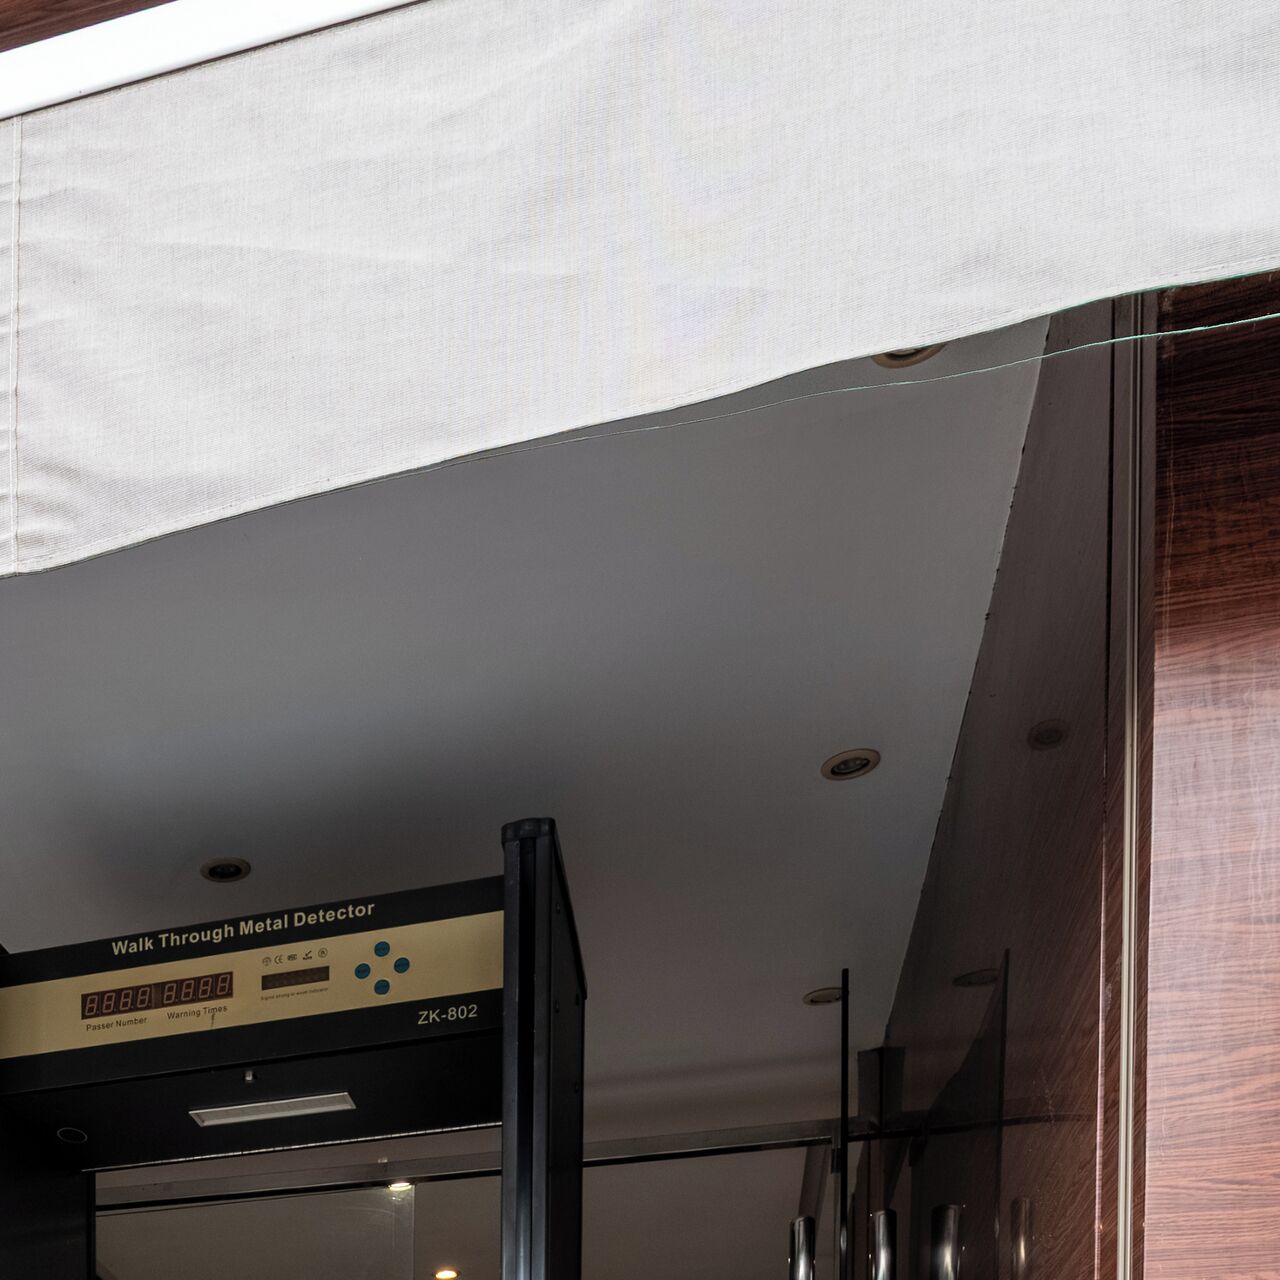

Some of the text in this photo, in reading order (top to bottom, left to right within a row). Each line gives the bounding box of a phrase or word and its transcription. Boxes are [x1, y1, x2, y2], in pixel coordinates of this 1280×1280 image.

[112, 902, 375, 955] Walk Through Metal Detector
[167, 1005, 228, 1020] Warning Times
[417, 1004, 478, 1025] ZK-802
[86, 1017, 147, 1031] Passer Number
